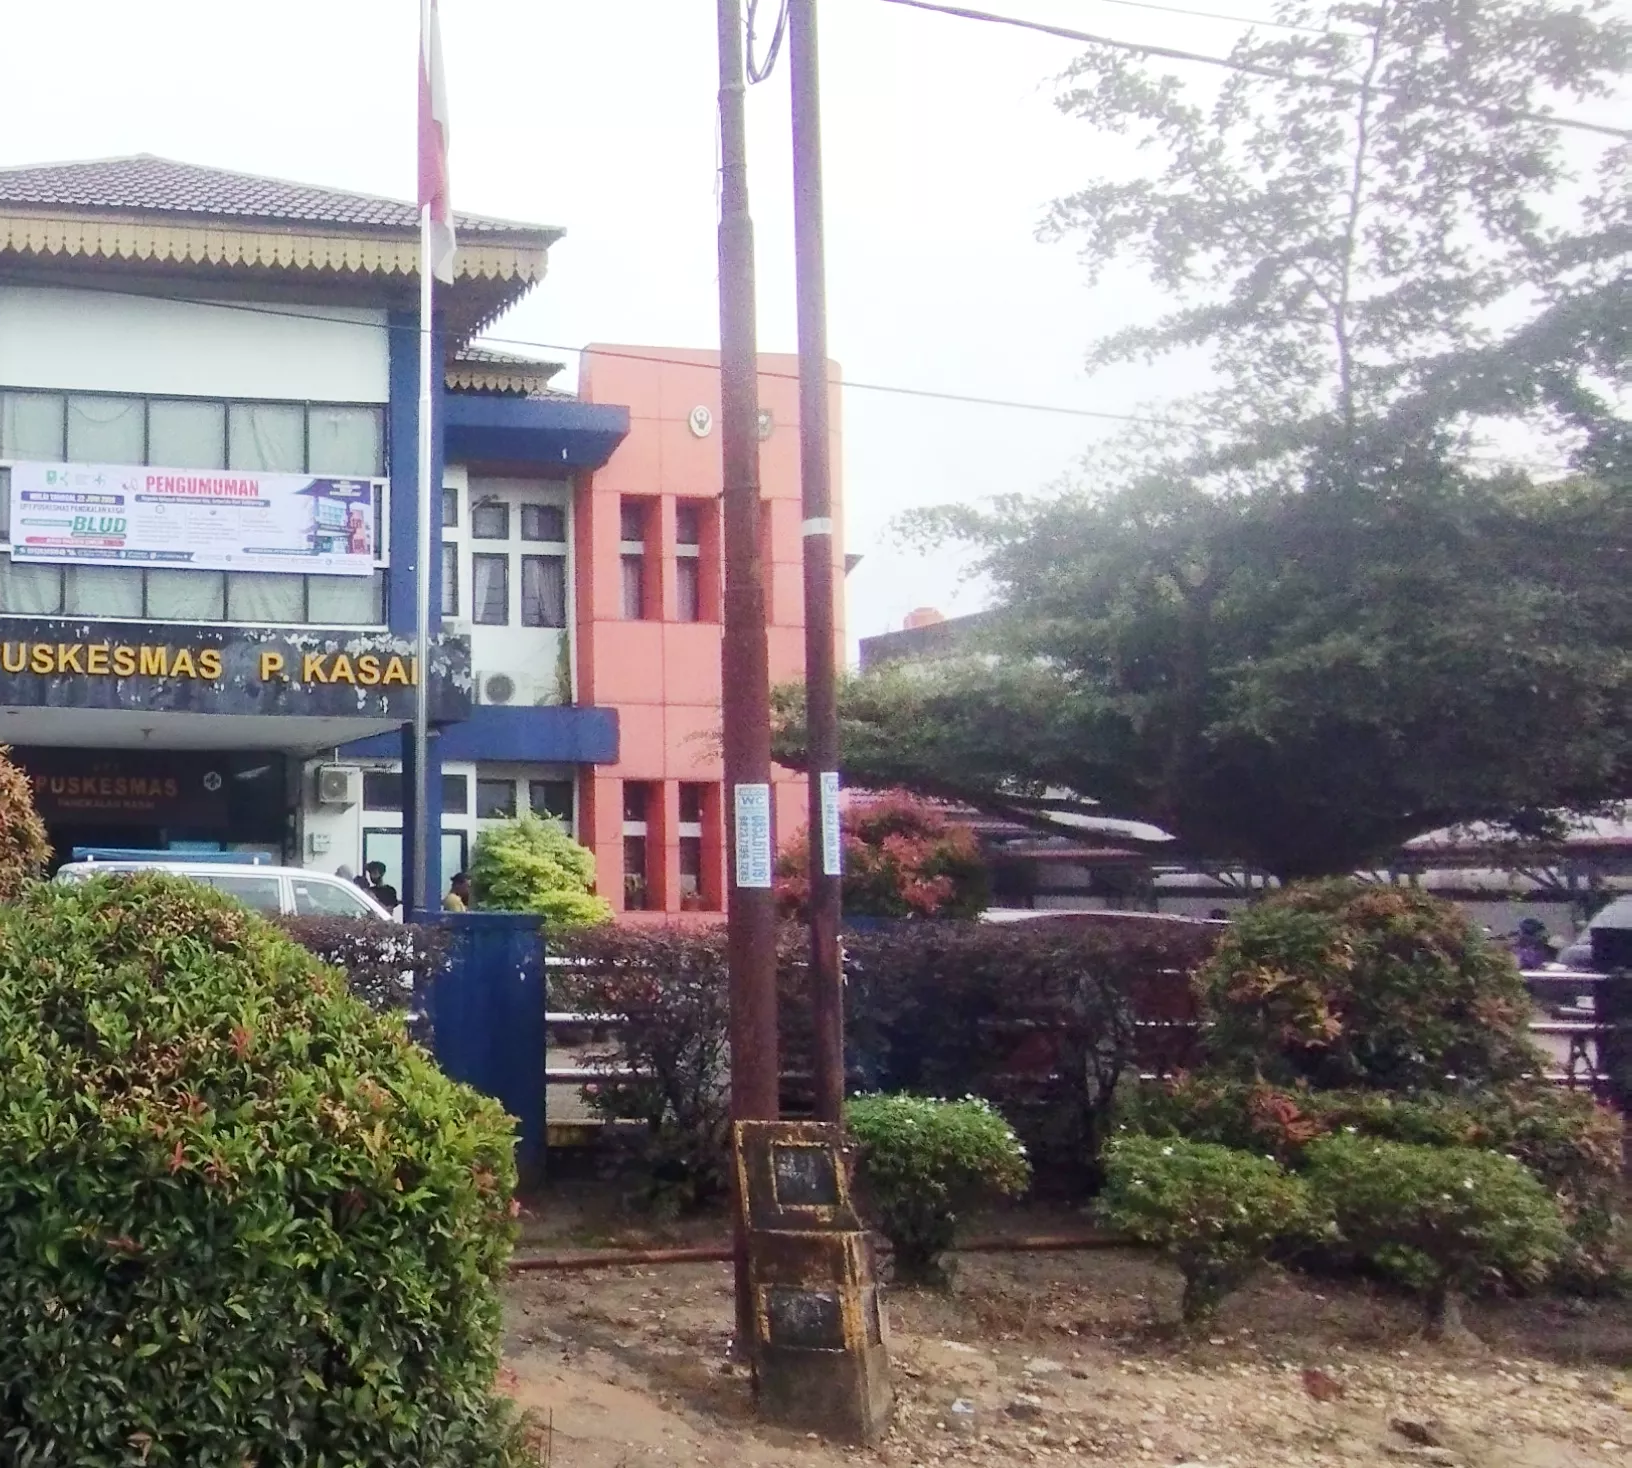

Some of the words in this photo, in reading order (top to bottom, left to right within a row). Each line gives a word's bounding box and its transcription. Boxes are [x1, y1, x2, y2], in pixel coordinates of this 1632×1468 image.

[146, 475, 259, 497] PENGUMUMAN
[73, 515, 127, 533] BLUD
[261, 652, 289, 683] P.
[303, 652, 419, 685] KASAI
[36, 775, 179, 798] PUSKESMAS
[741, 796, 765, 805] WC
